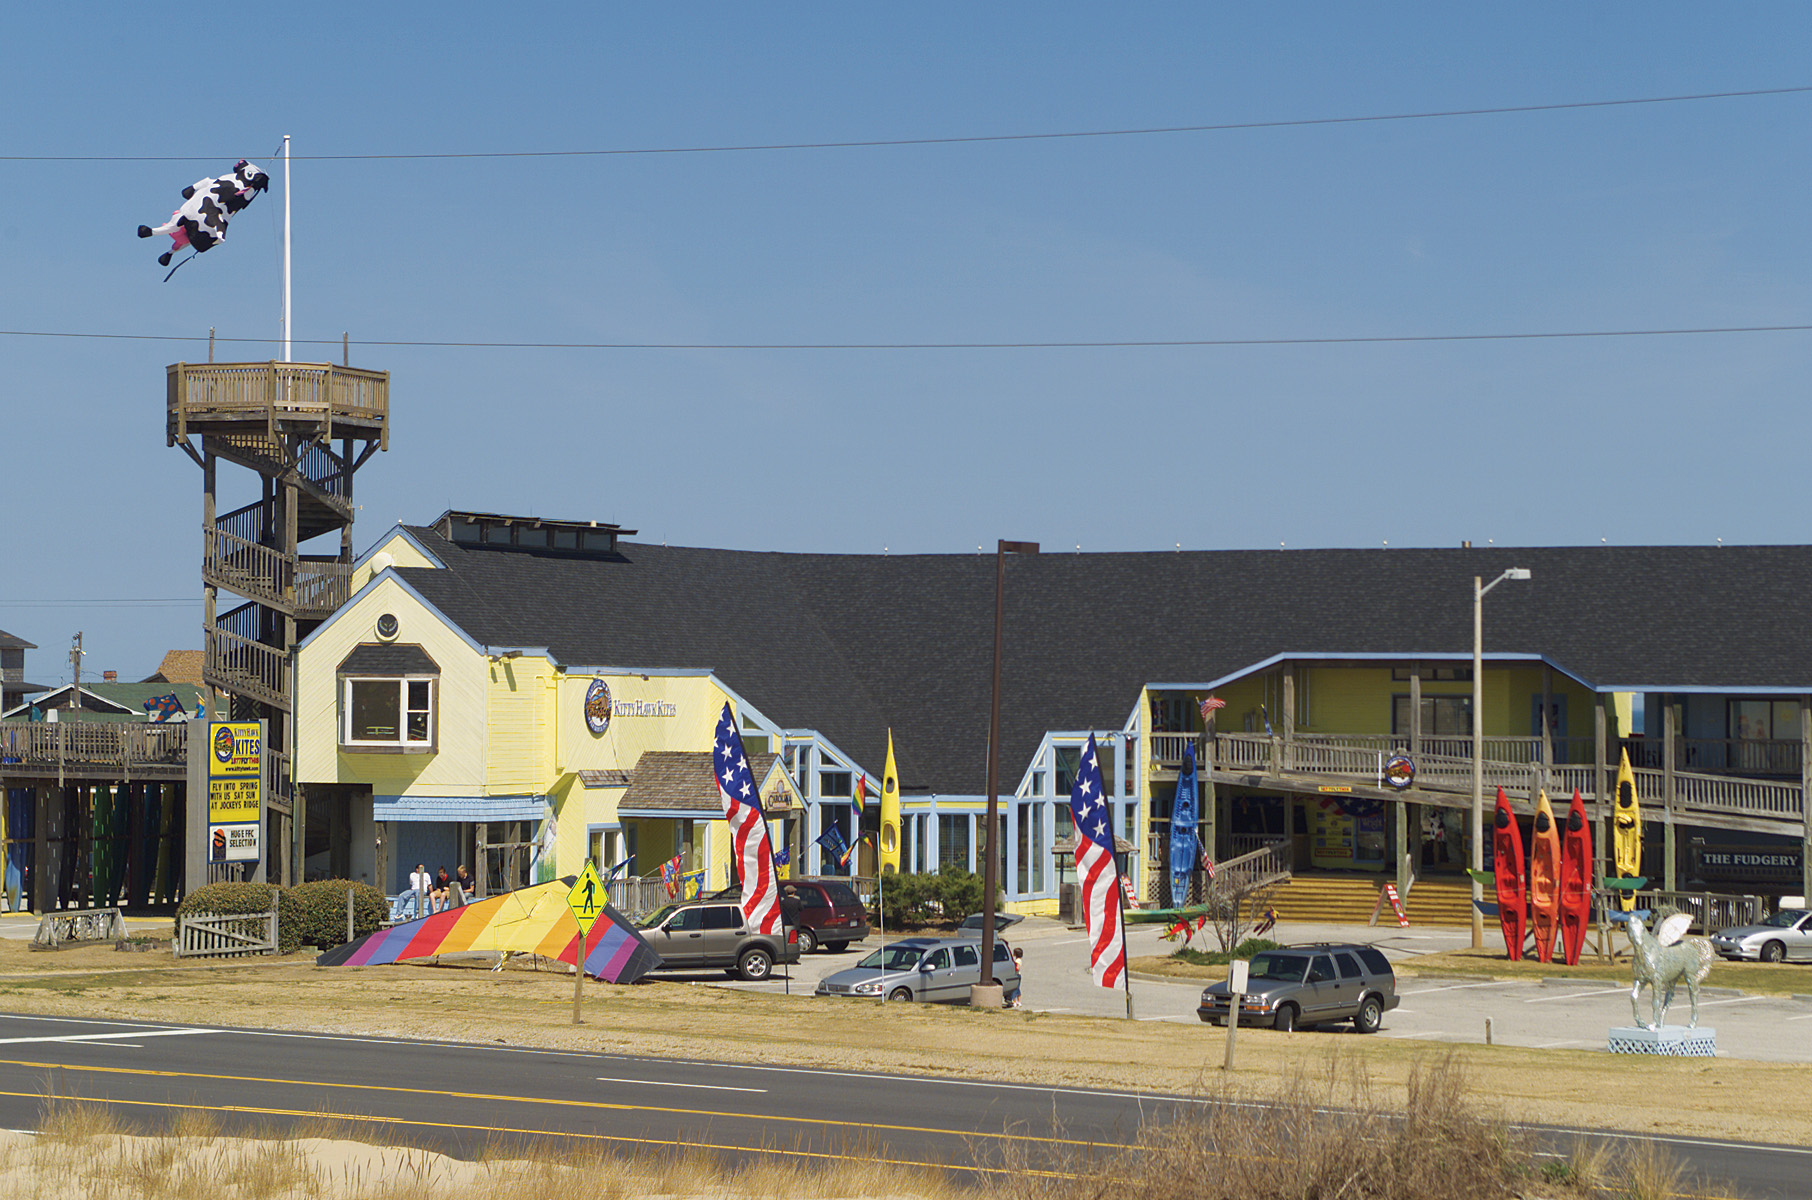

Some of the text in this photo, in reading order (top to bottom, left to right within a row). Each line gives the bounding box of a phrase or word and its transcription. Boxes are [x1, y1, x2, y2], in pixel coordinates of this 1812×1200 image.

[235, 739, 260, 755] KITES
[224, 782, 235, 790] INTO
[240, 782, 258, 790] SPRING
[224, 792, 231, 800] US
[234, 791, 244, 799] SAT
[246, 791, 255, 799] SUN
[211, 801, 217, 809] AT
[243, 800, 259, 809] RIDGE
[229, 838, 257, 847] SELECTION
[1703, 853, 1798, 866] THE FUDGERY
